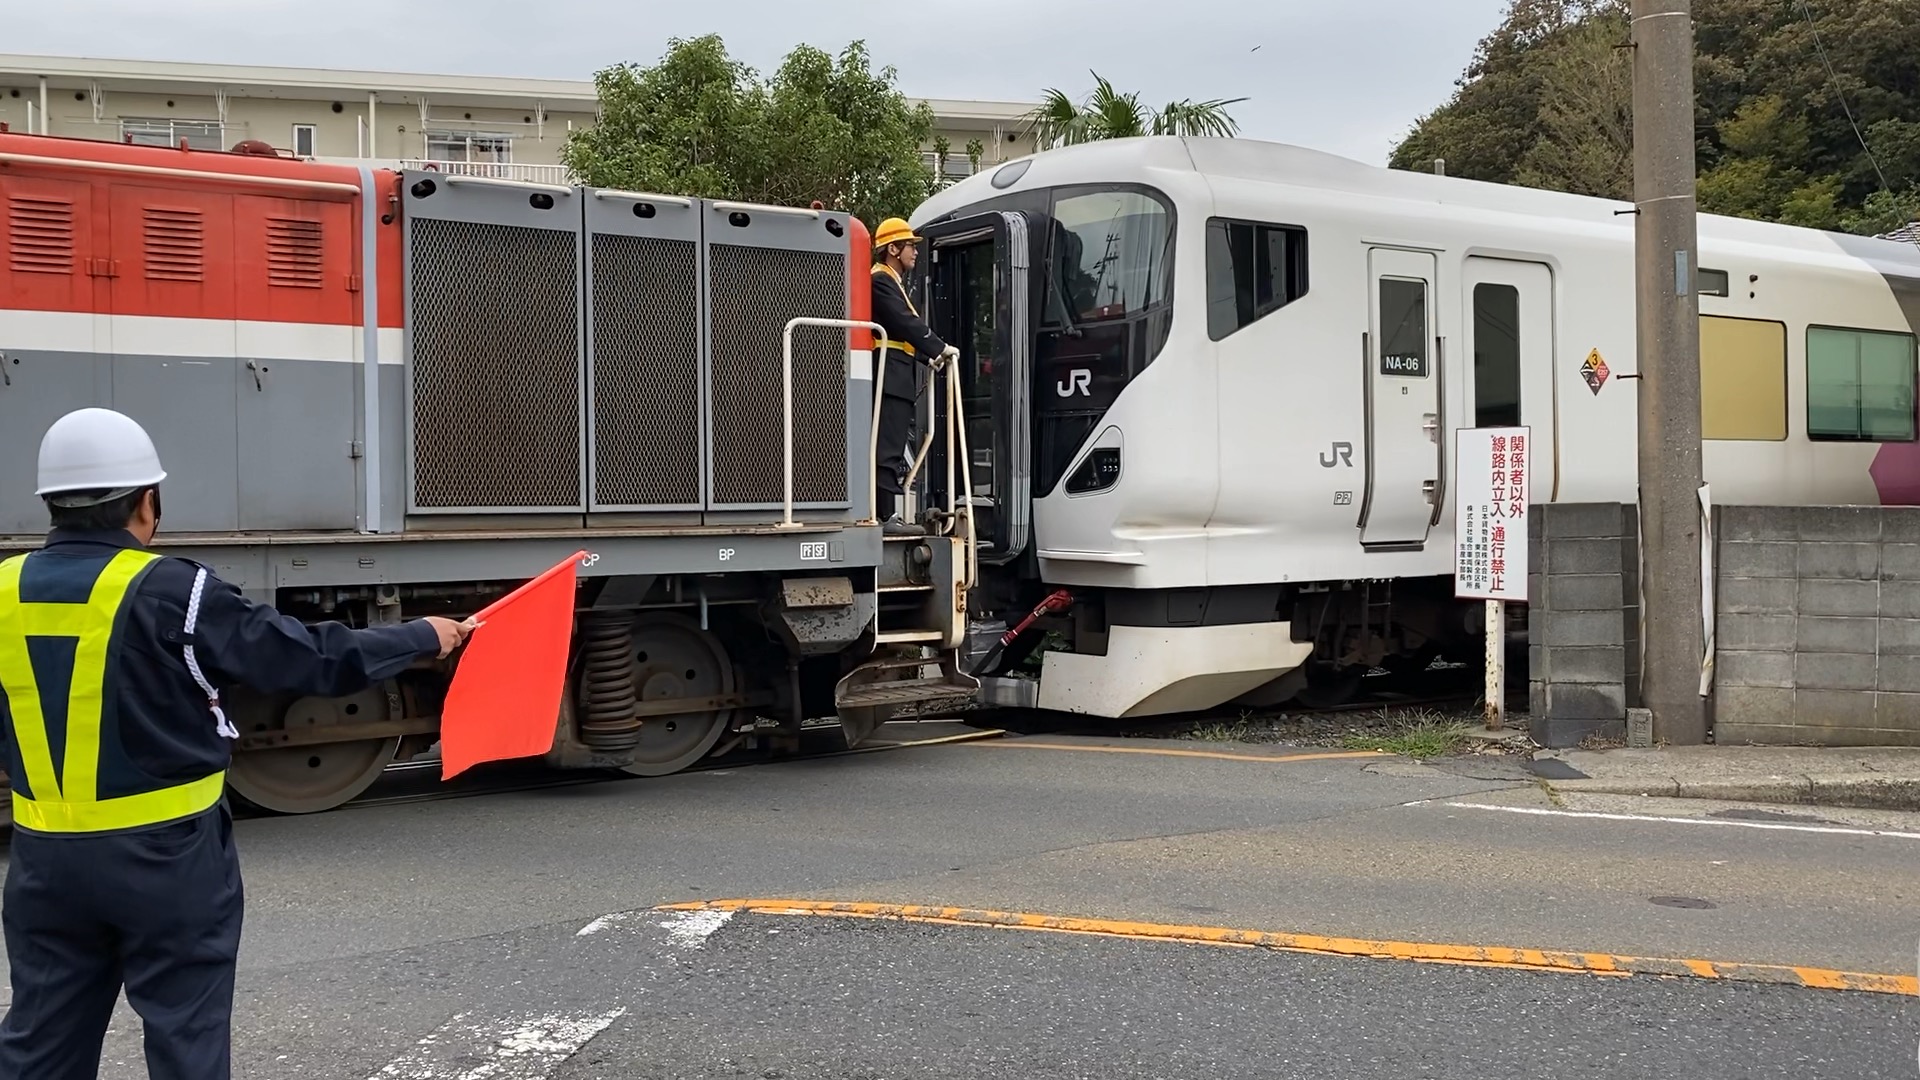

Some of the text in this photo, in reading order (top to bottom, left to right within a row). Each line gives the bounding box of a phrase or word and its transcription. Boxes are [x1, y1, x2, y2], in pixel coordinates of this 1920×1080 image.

[1385, 355, 1419, 371] NA-06
[1591, 353, 1598, 366] 3
[1057, 368, 1092, 398] JR
[1319, 441, 1353, 468] JR
[1509, 435, 1525, 519] 関係者以外
[1490, 436, 1506, 592] 線路内立入・通行禁止
[582, 553, 600, 567] CP
[719, 548, 736, 561] BP
